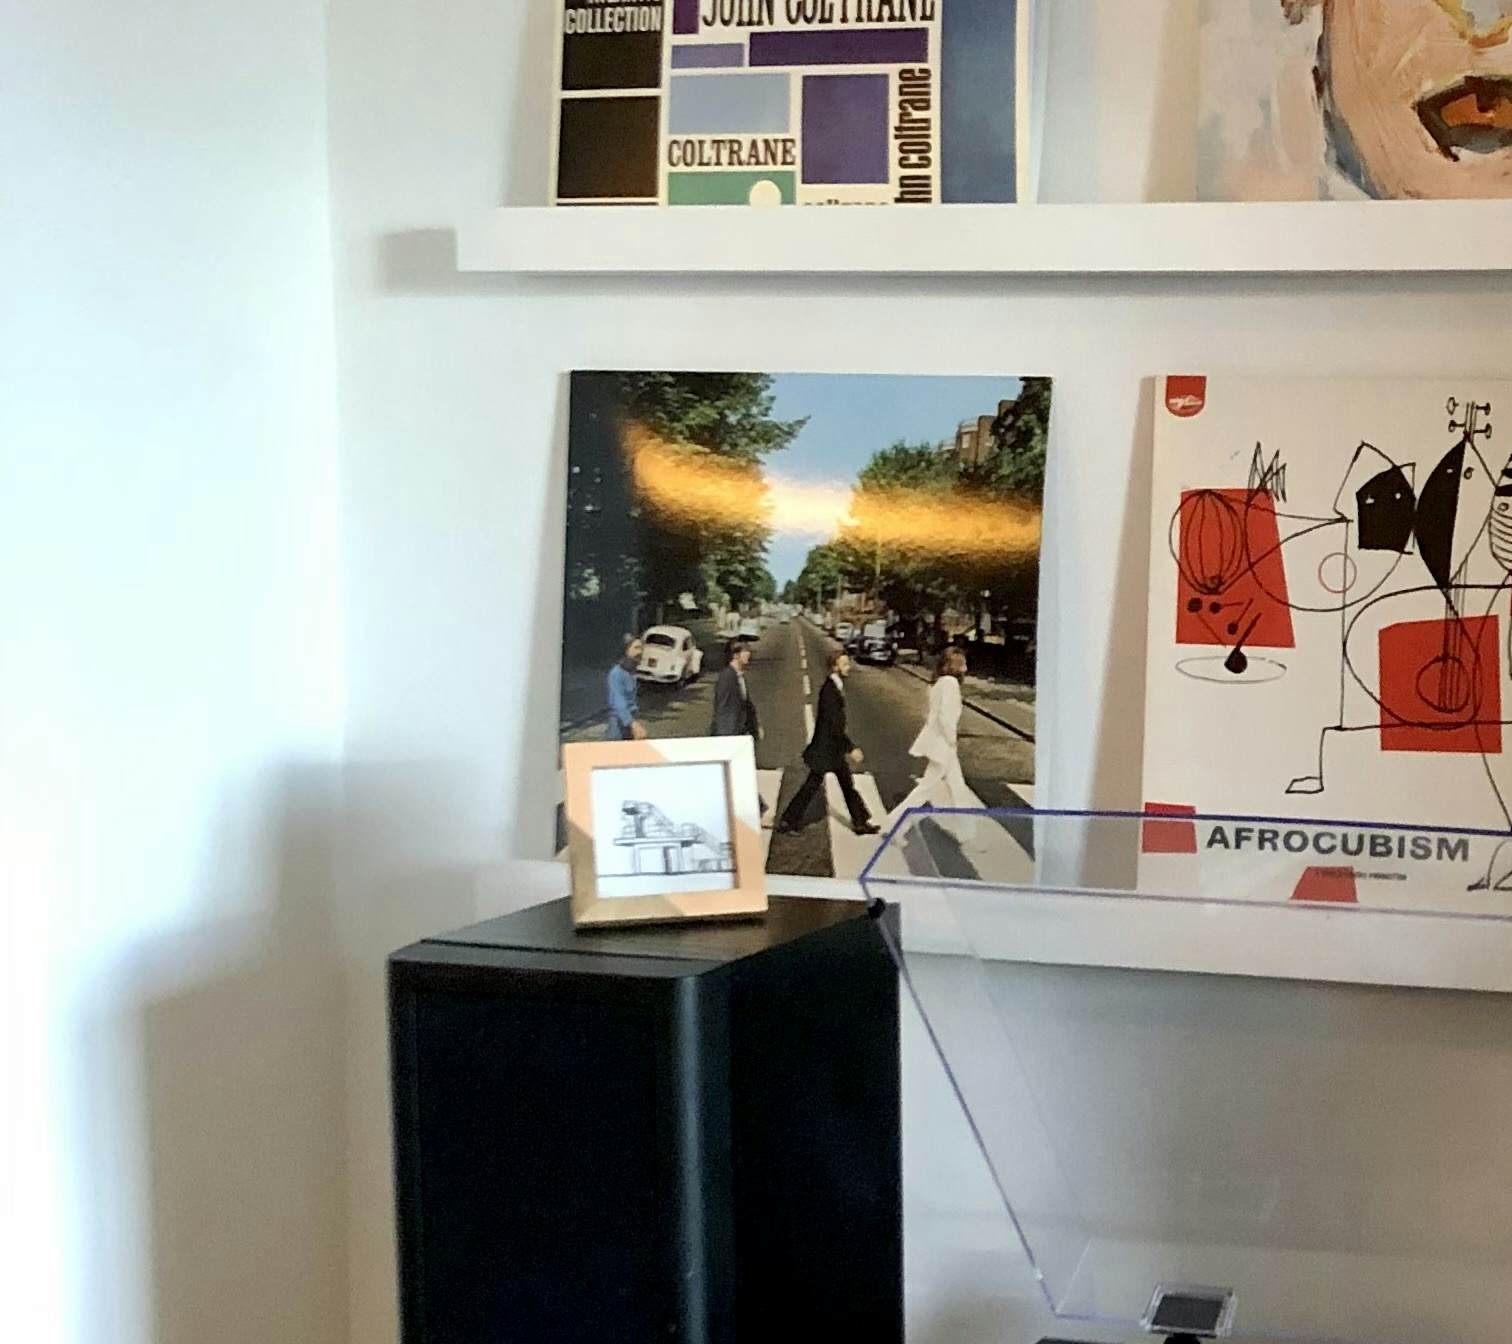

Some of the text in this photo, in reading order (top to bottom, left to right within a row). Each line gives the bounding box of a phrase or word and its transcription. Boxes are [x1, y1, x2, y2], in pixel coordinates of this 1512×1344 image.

[565, 6, 662, 34] COLLECTION
[894, 67, 932, 171] coltrane
[667, 137, 797, 168] COLTRANE
[1206, 825, 1470, 862] AFROCUBISM
